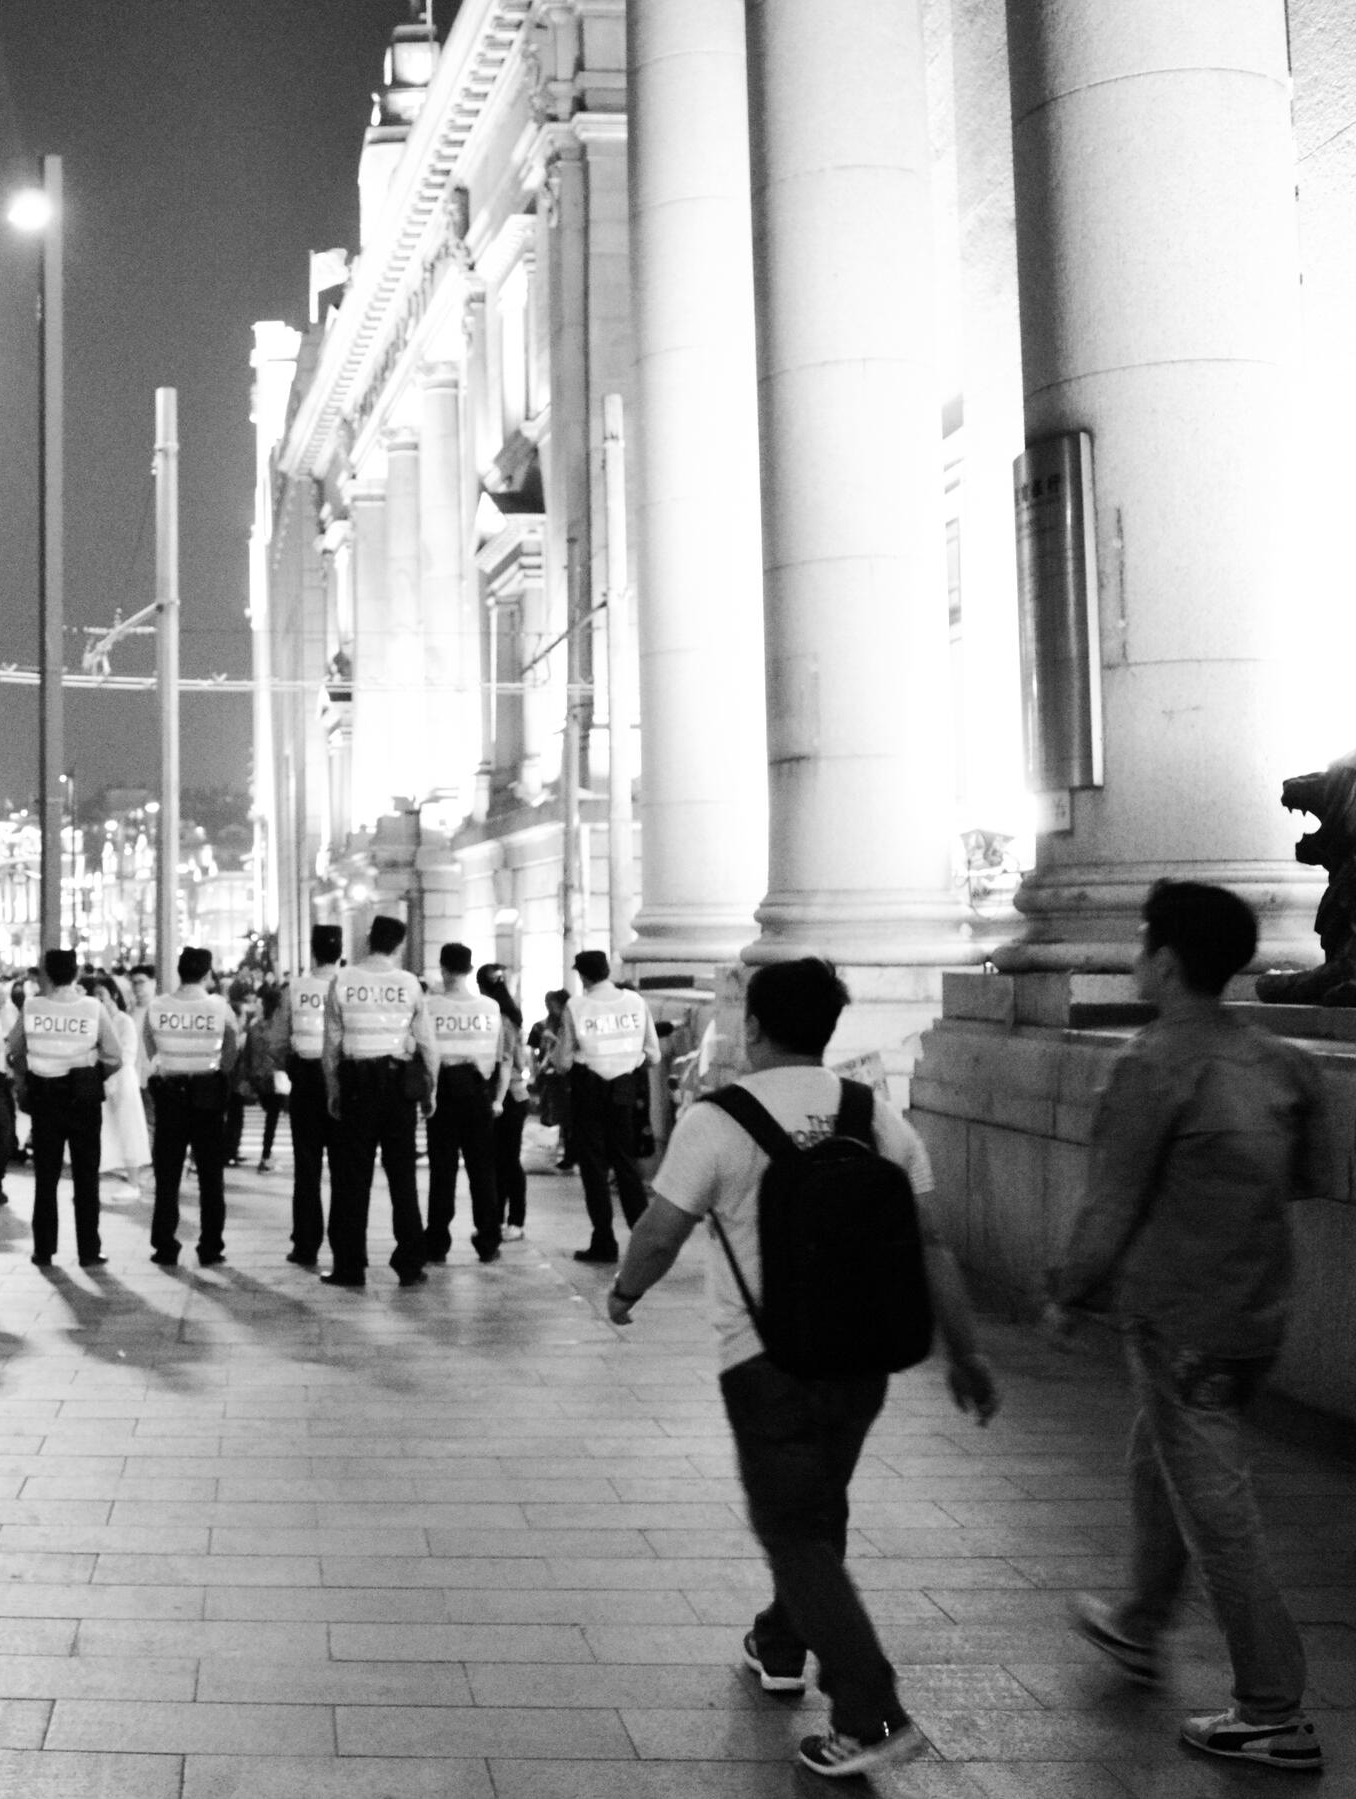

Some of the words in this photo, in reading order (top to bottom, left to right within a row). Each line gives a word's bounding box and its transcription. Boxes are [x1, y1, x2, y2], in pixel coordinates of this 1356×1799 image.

[35, 1016, 88, 1034] POLICE
[159, 1014, 215, 1031] POLICE
[435, 1016, 492, 1032] POLICE
